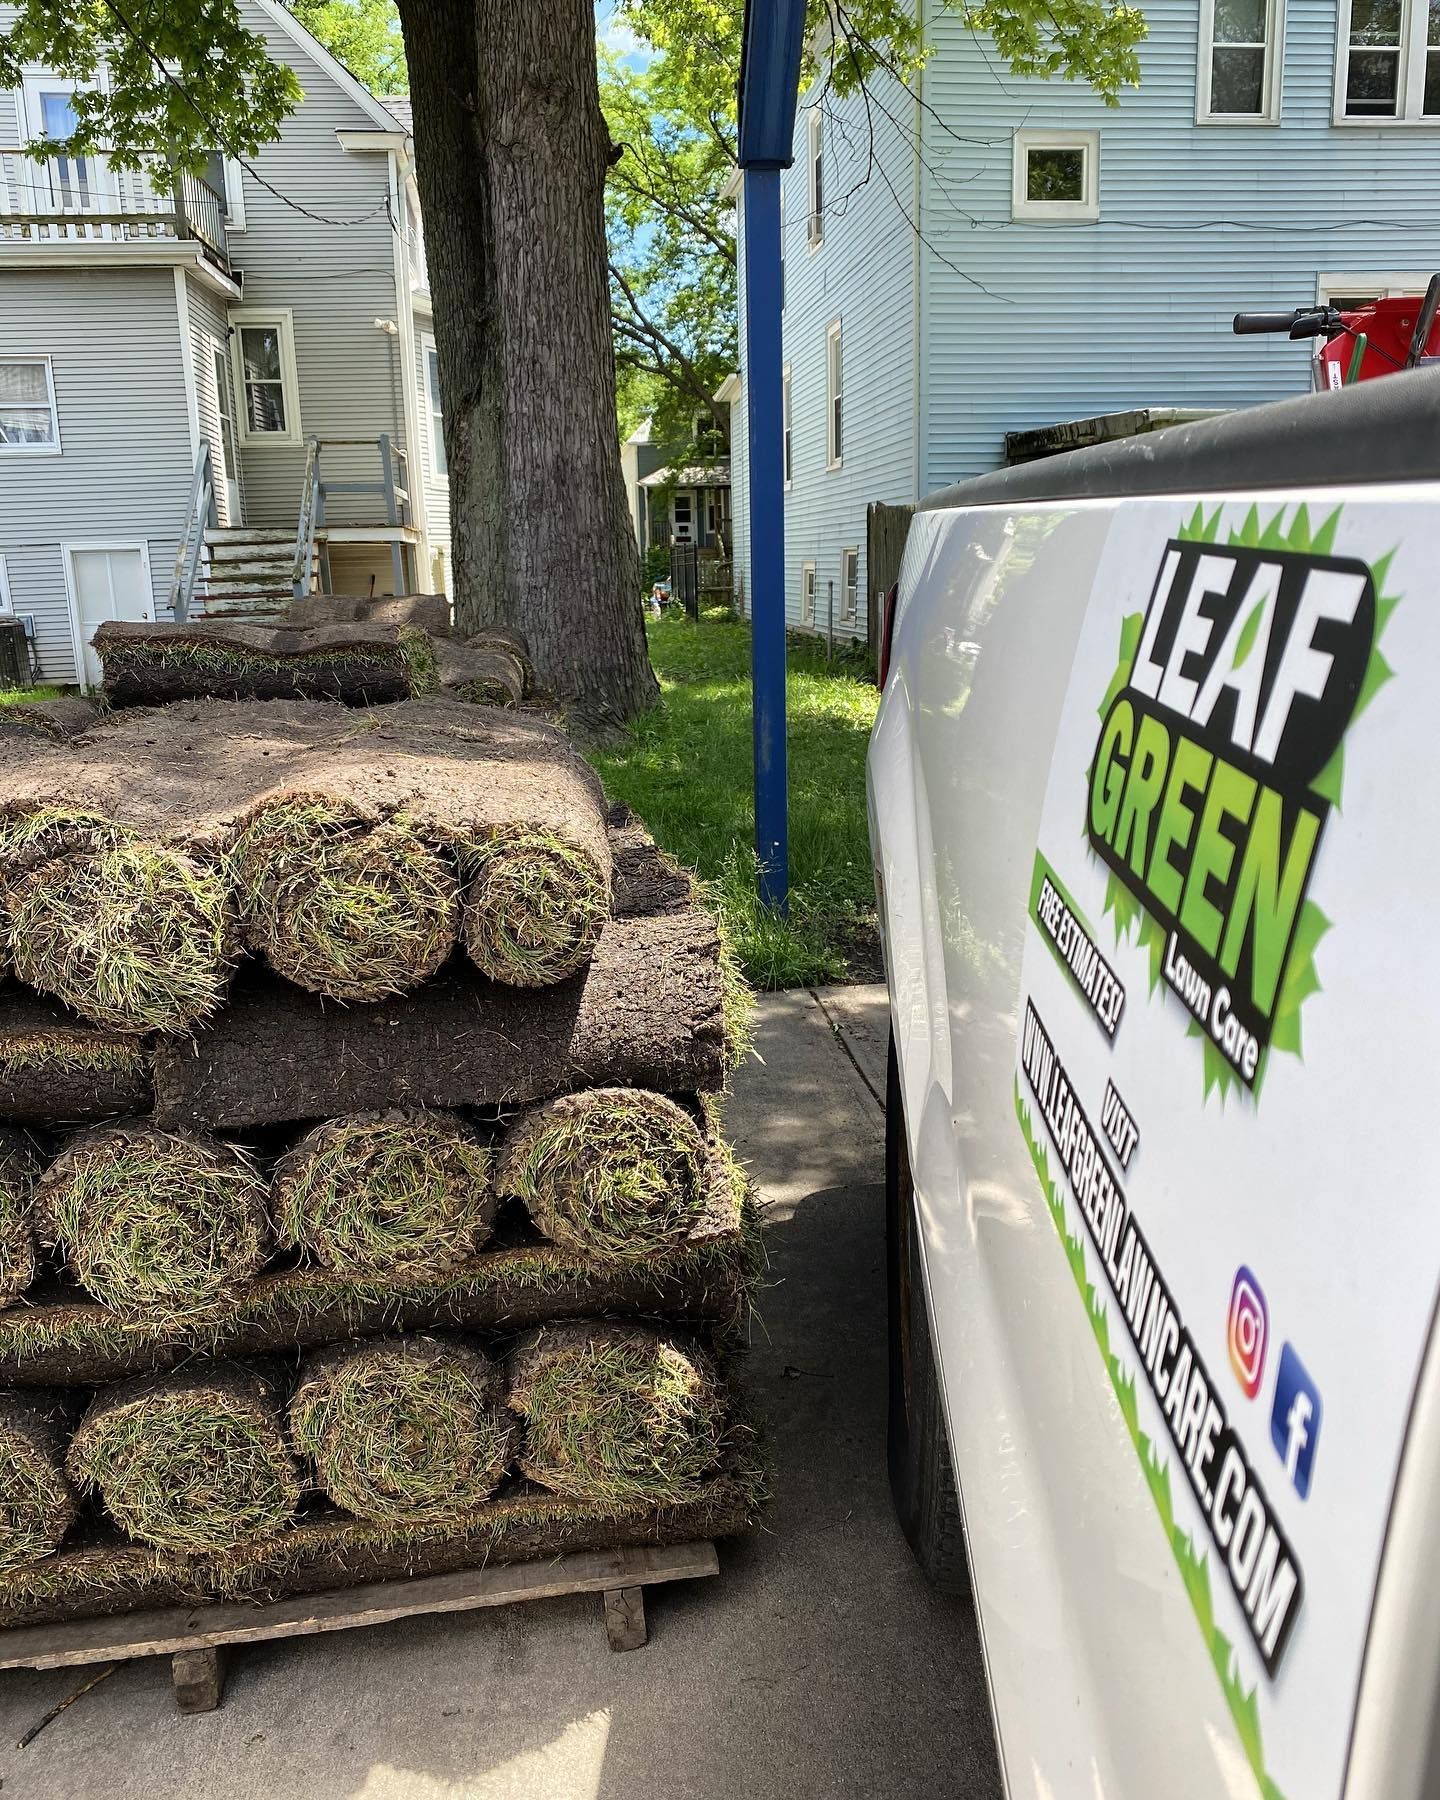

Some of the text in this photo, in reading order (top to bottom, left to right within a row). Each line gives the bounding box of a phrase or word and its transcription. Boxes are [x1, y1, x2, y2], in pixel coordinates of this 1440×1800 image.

[1130, 550, 1367, 765] LEAF
[1091, 699, 1320, 1018] GREEN
[1038, 878, 1125, 1034] FREE ESTIMATES!
[1165, 930, 1260, 1079] Lawn Care
[1102, 1086, 1138, 1165] VISIT
[1023, 1004, 1298, 1658] WWW.LEAFGREENLAWNCARE.COM
